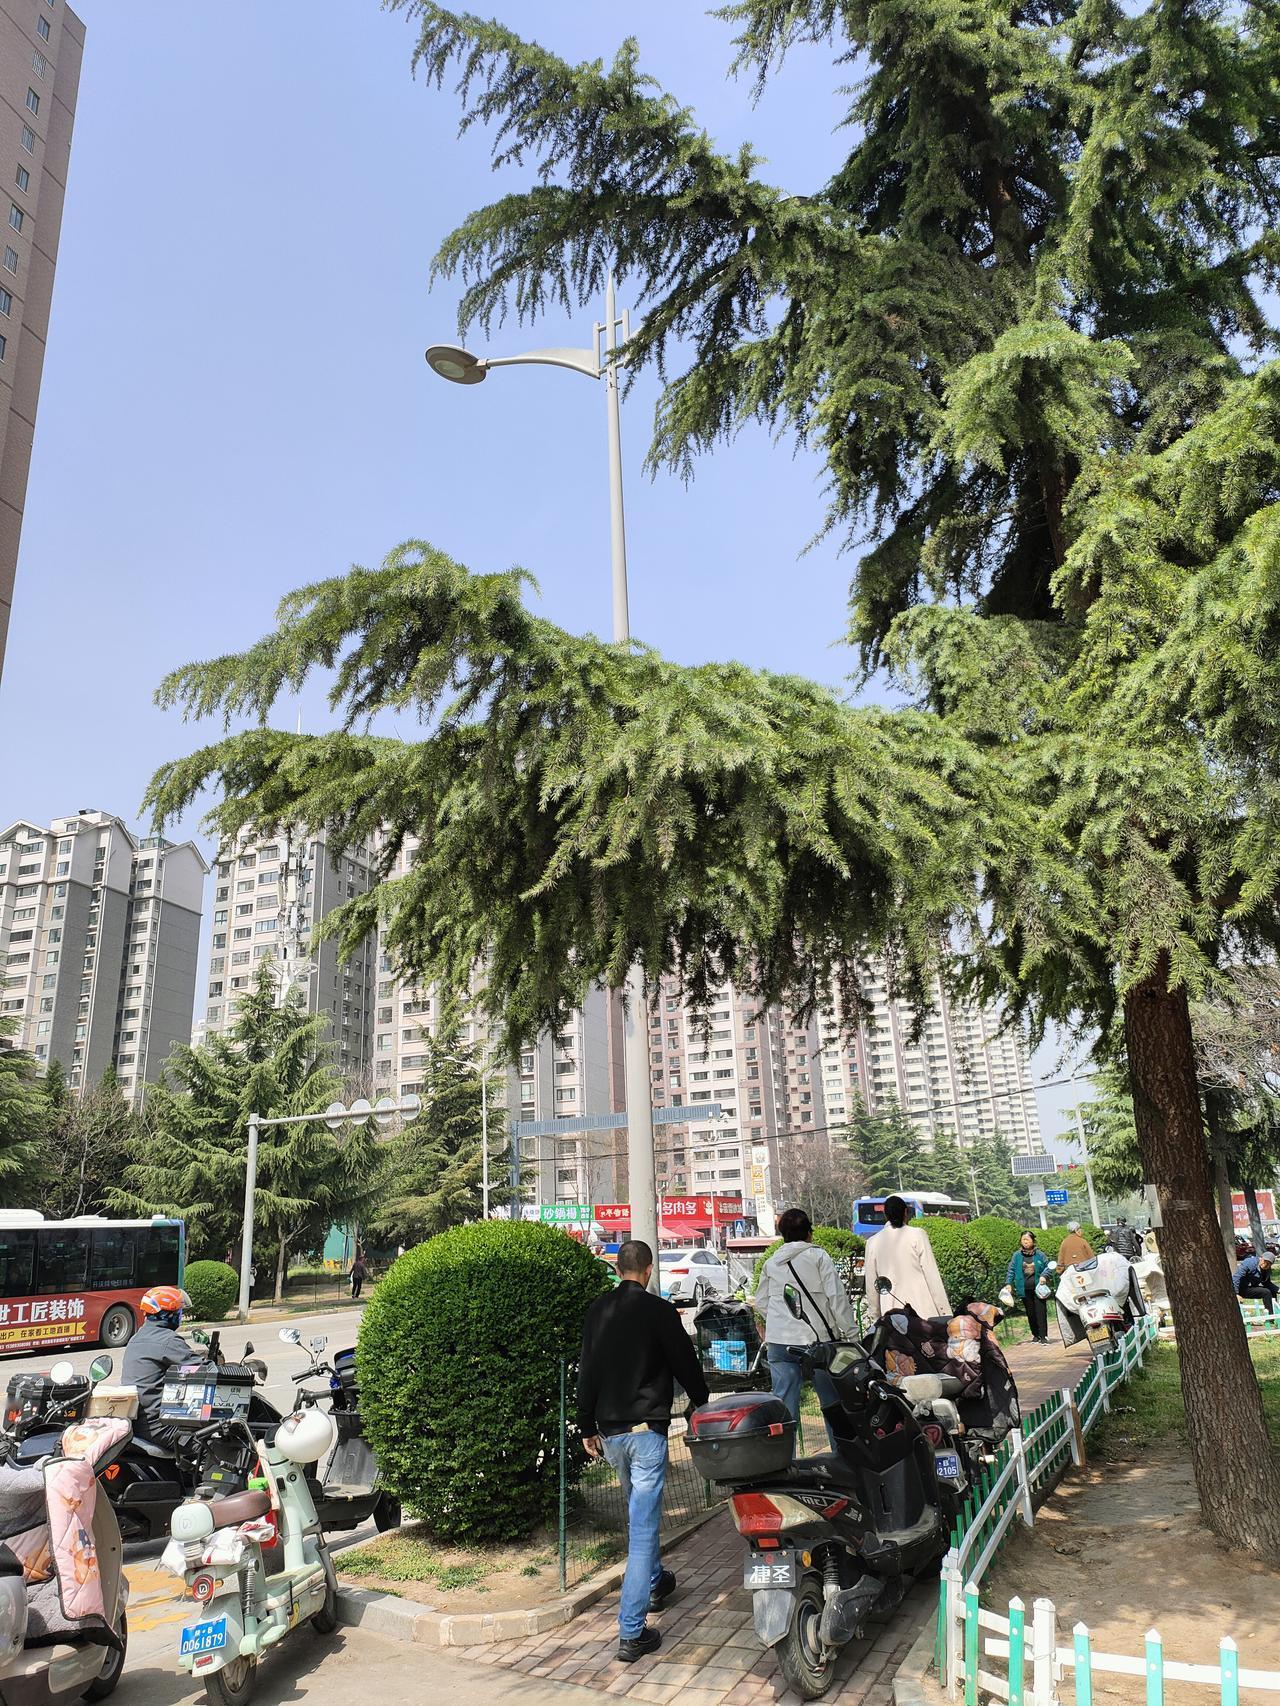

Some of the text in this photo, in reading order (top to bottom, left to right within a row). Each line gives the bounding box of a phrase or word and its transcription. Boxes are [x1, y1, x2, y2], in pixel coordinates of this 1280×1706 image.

[657, 1201, 697, 1215] 多肉多
[182, 1632, 223, 1653] 0061879
